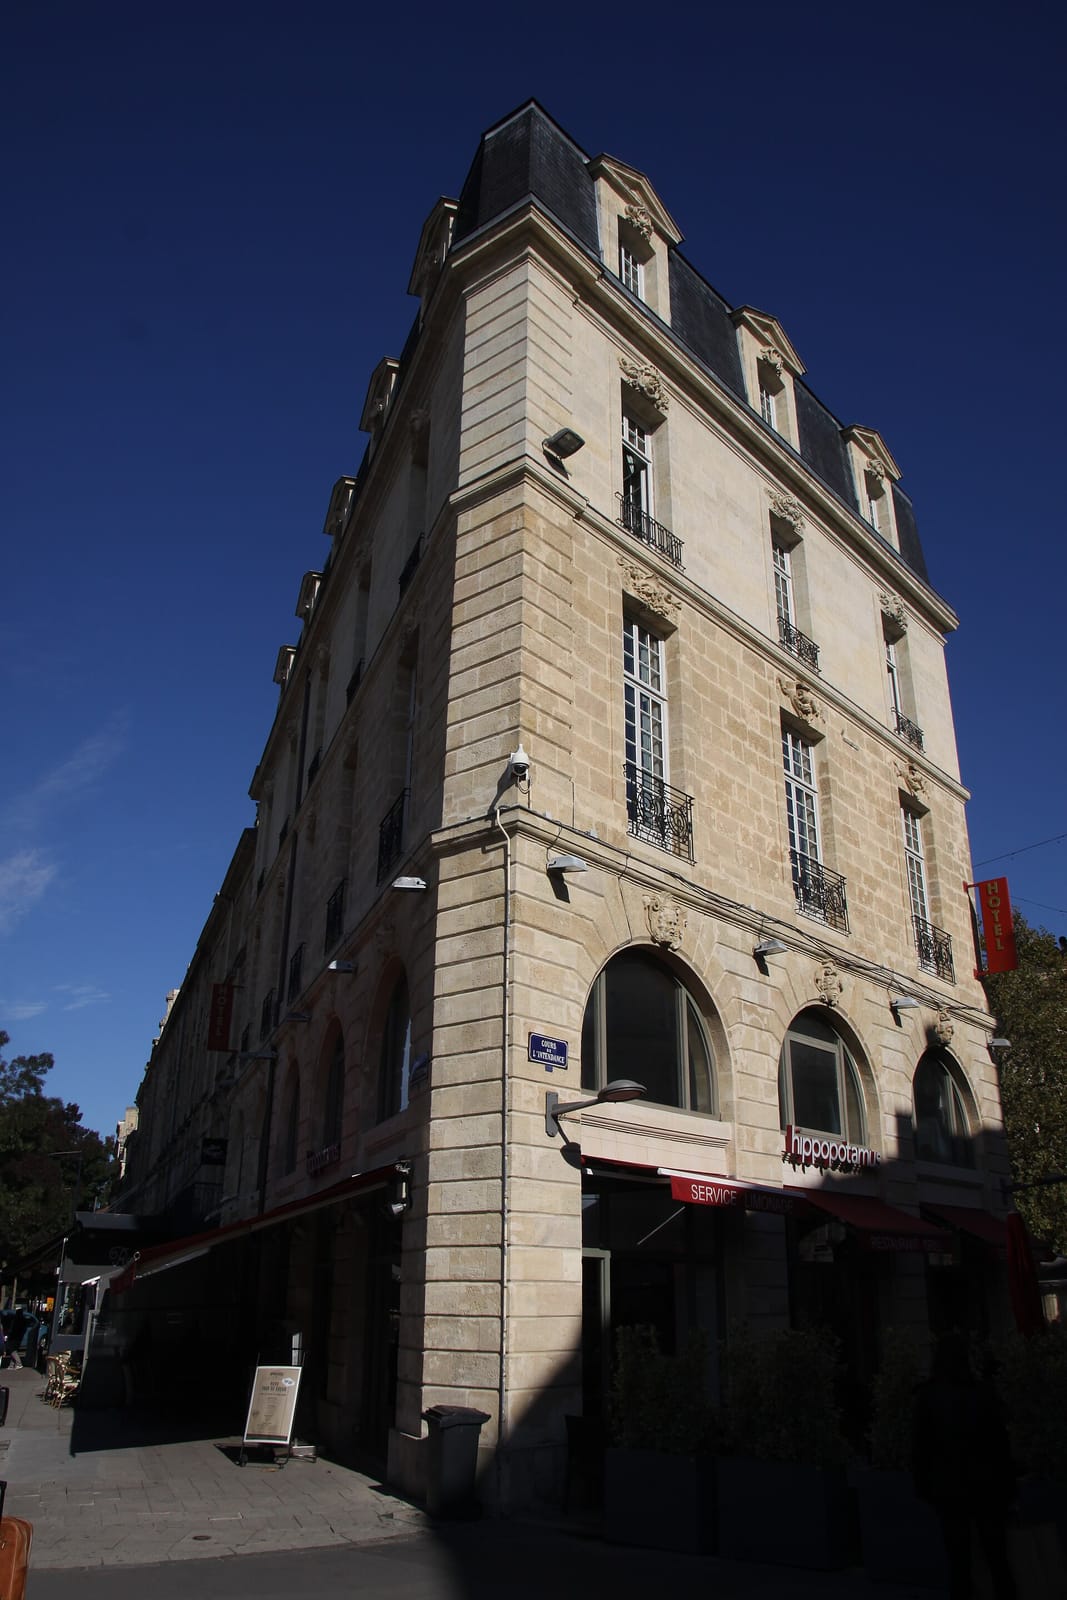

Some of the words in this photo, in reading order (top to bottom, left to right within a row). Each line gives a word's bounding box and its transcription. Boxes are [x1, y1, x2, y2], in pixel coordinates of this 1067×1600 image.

[986, 881, 1005, 951] HOTEL
[541, 1039, 557, 1050] COURS
[532, 1049, 566, 1064] L'INTENDANCE
[791, 1125, 882, 1168] hippopotamus
[691, 1184, 737, 1206] SERVICE
